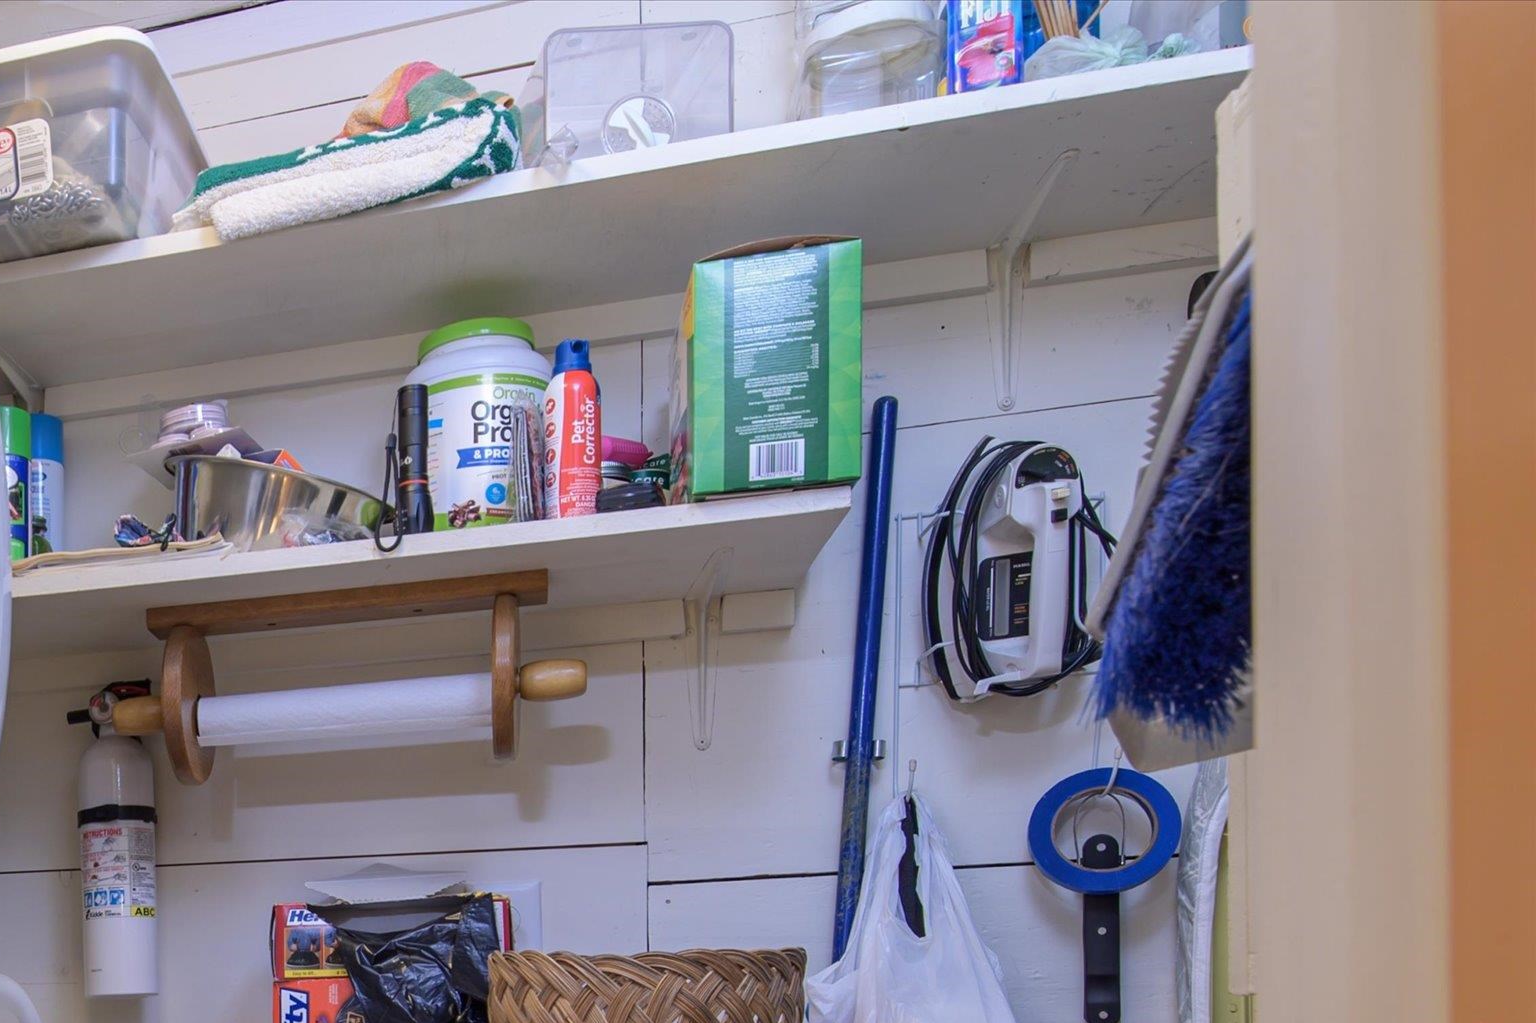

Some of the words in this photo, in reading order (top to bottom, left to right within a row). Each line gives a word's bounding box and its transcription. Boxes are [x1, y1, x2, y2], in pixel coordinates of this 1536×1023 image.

[471, 400, 512, 425] Org
[473, 423, 513, 444] Pro
[571, 419, 584, 444] Pet
[583, 397, 596, 464] Corrector
[473, 451, 482, 459] &
[484, 448, 510, 459] PRO
[135, 907, 156, 917] ABC
[289, 910, 317, 923] He
